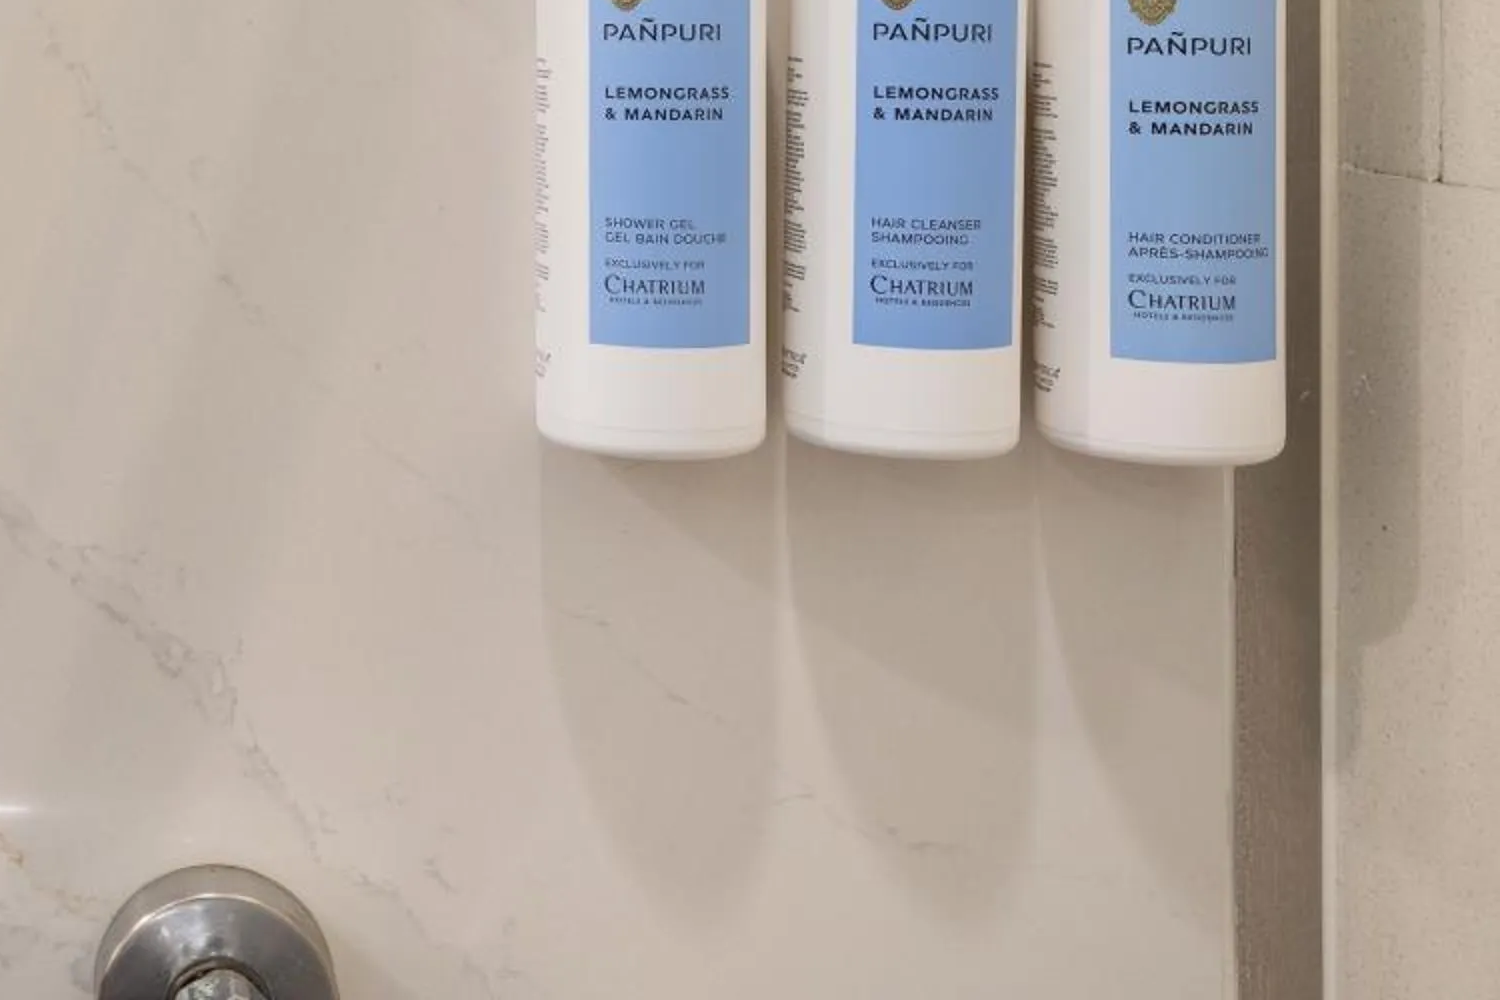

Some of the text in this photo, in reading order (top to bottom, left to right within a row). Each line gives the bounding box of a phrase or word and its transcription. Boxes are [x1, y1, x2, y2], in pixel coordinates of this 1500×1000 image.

[603, 17, 720, 41] PAÑPURI
[873, 17, 993, 42] PAÑPURI
[1127, 31, 1251, 56] PAÑPURI
[605, 86, 729, 100] LEMONGRASS
[873, 86, 999, 100] LEMONGRASS
[605, 107, 723, 120] & MANDARIN
[873, 107, 993, 121] & MANDARIN
[1129, 100, 1259, 114] LEMONGRASS
[1129, 121, 1253, 136] & MANDARIN
[605, 217, 694, 230] SHOWER GEL
[871, 217, 981, 230] HAIR CLEANSER
[605, 232, 629, 243] GEL
[635, 233, 669, 244] BAIN
[871, 231, 969, 245] SHAMPOOING
[1128, 232, 1261, 244] HAIR CONDITIONER
[604, 274, 705, 294] CHATRIUM
[870, 275, 973, 296] CHATRIUM
[1127, 289, 1235, 310] CHATRIUM
